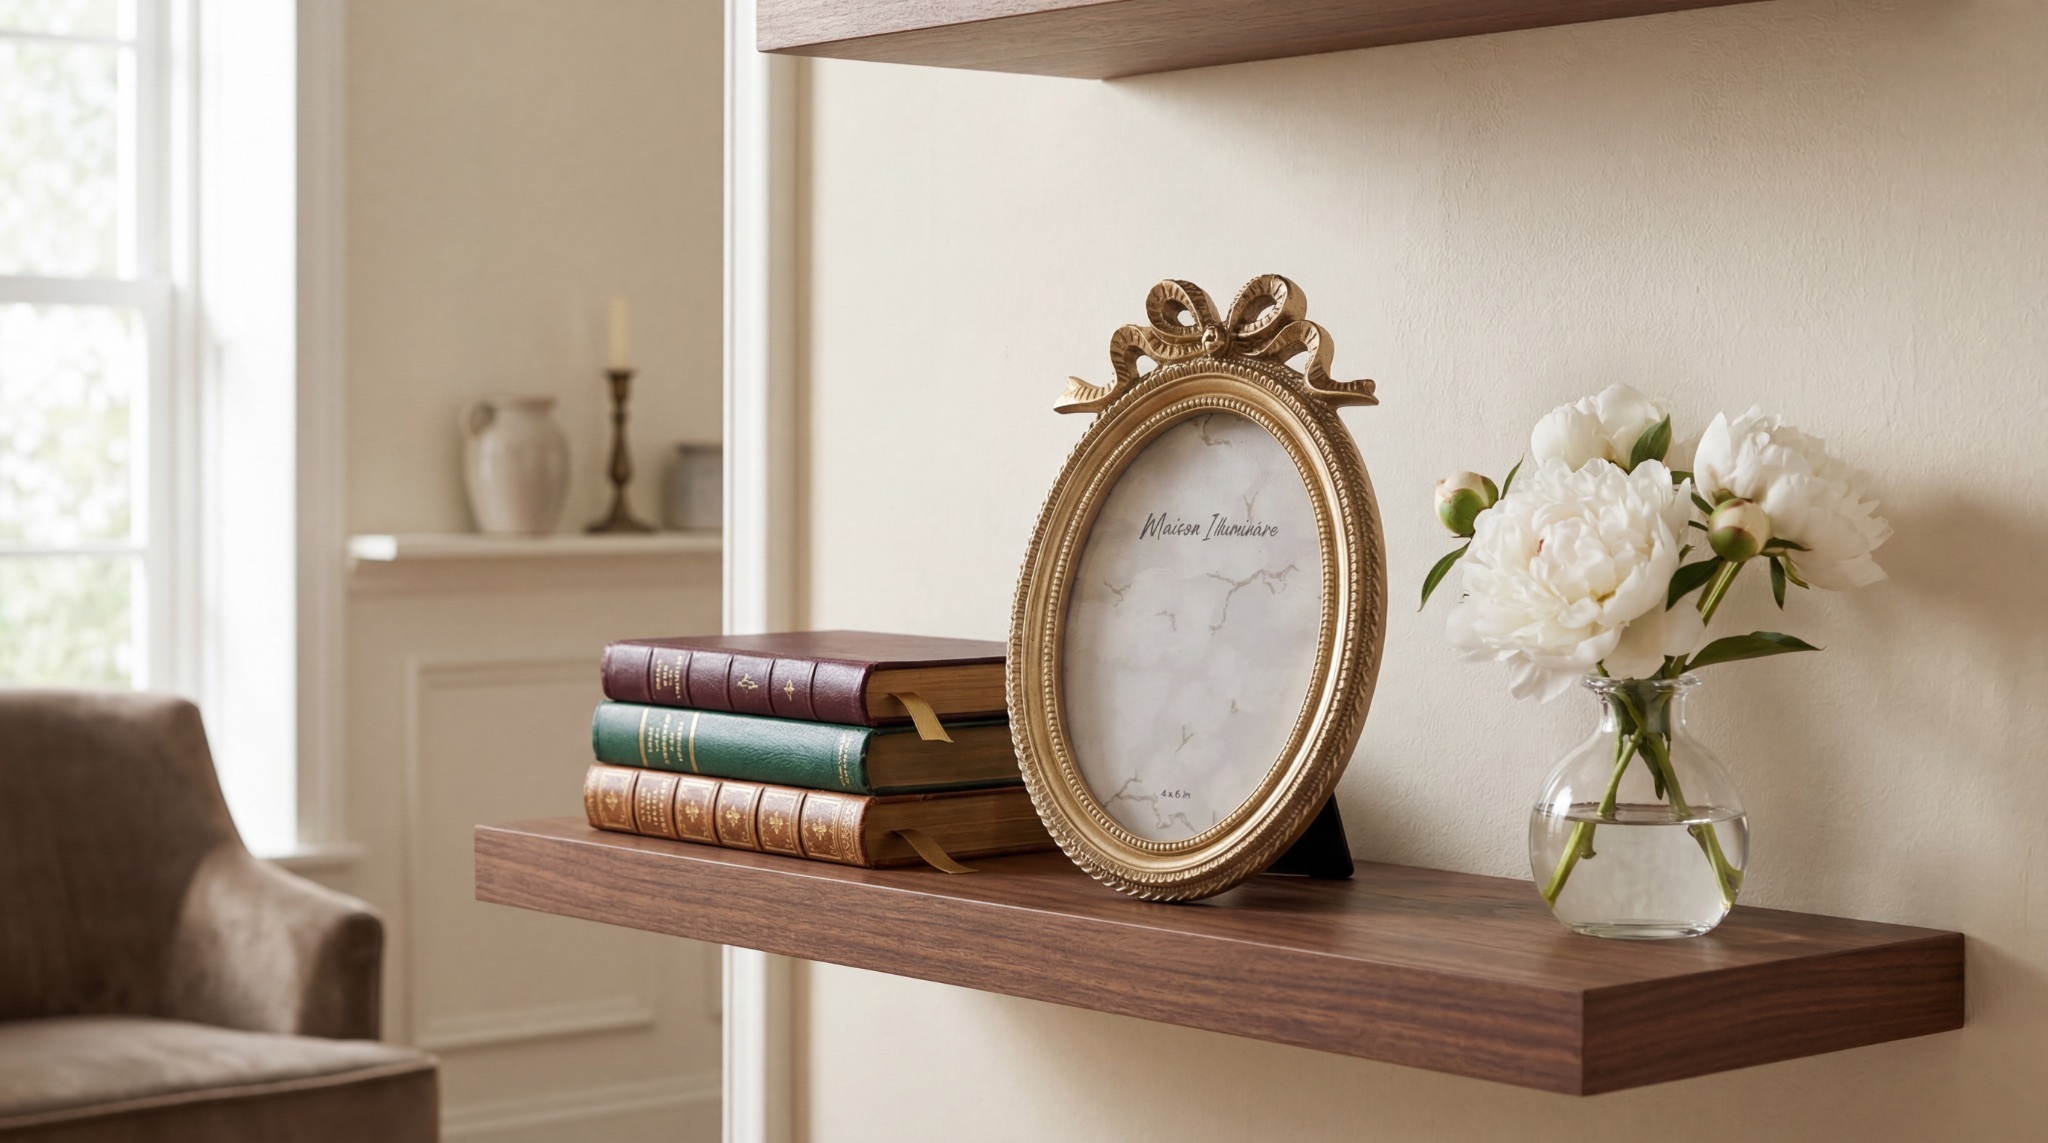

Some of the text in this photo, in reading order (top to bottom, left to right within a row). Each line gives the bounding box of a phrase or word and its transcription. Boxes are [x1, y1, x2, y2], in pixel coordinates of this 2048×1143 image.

[1139, 512, 1200, 540] Maison
[1160, 789, 1167, 797] 4
[1174, 789, 1181, 799] 6
